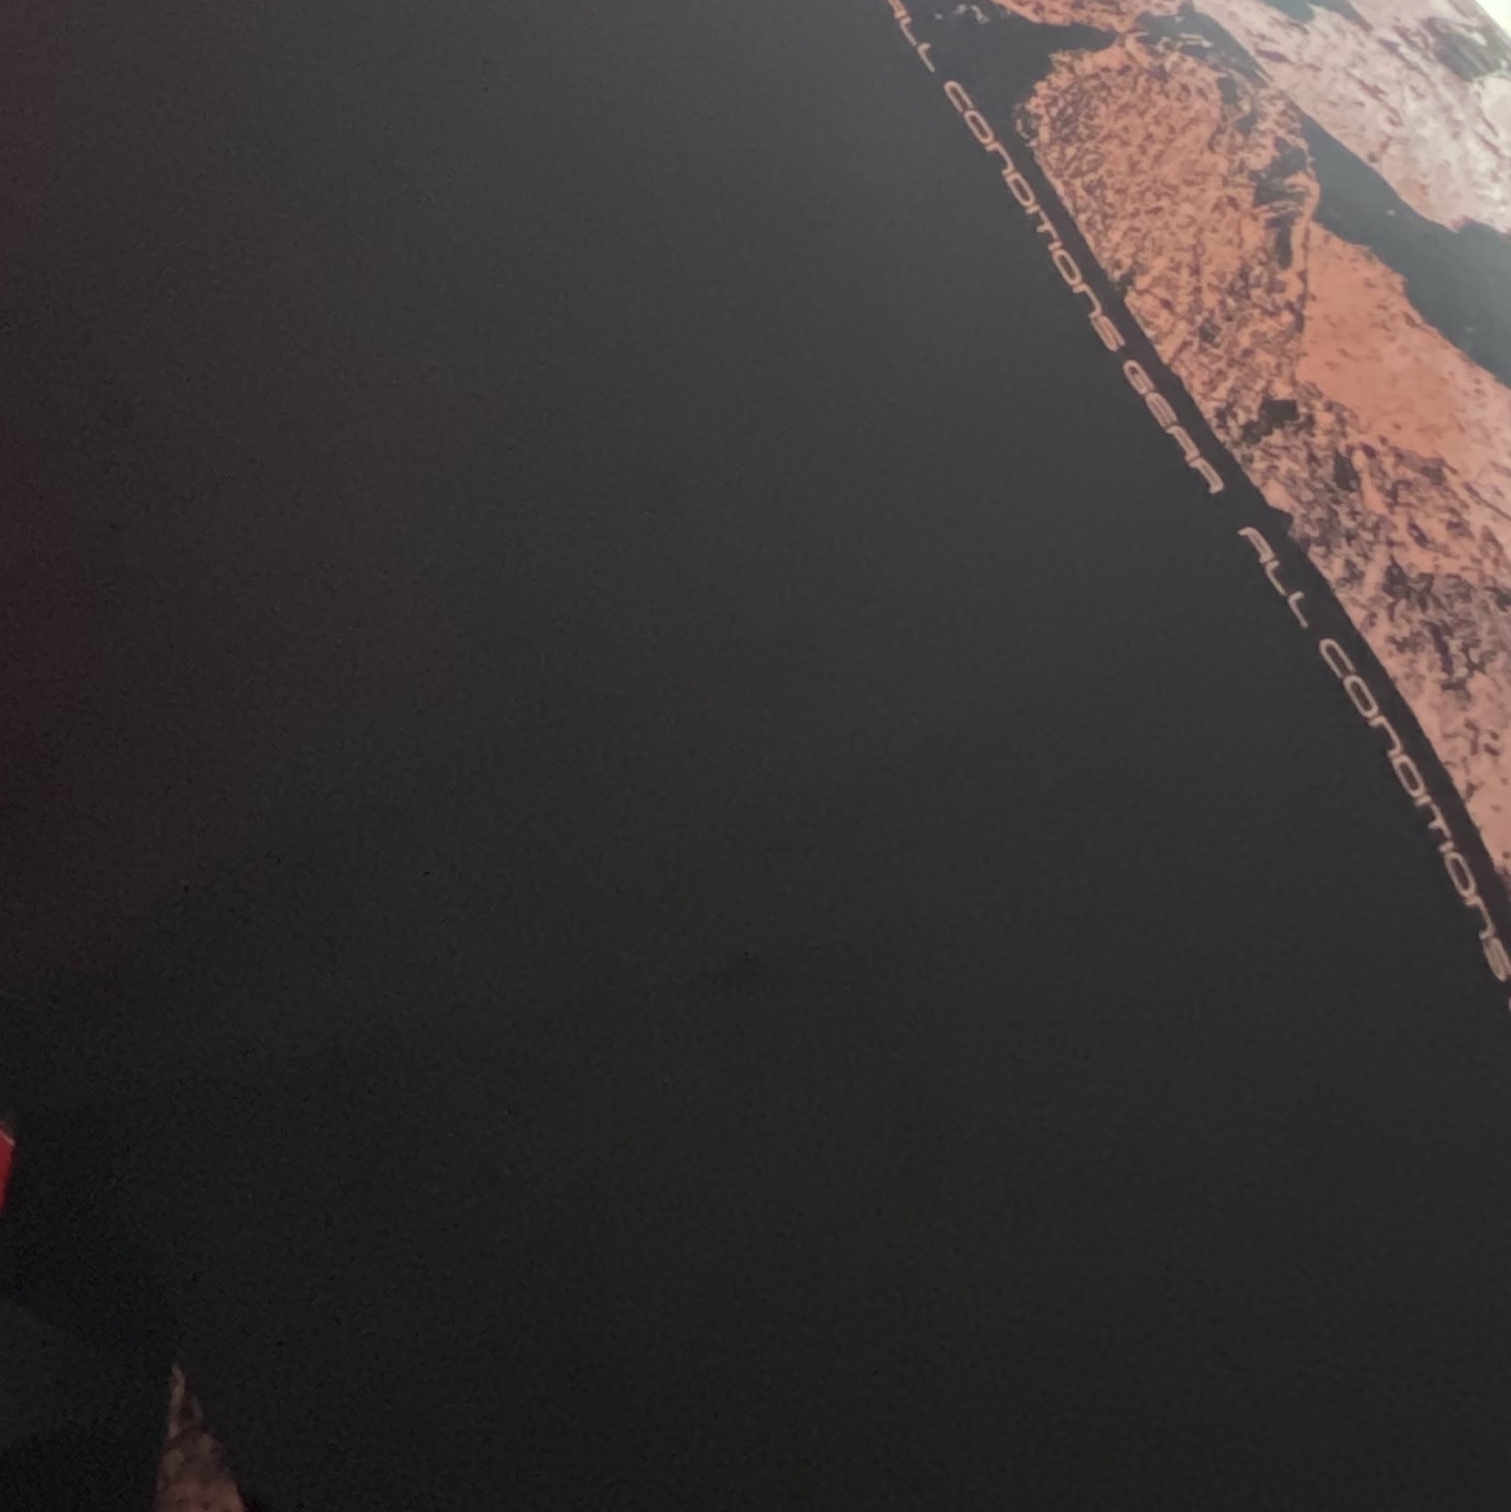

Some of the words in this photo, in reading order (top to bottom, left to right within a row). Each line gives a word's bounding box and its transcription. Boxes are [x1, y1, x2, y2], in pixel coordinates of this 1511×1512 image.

[944, 81, 1126, 352] CONDITIONS
[1123, 359, 1224, 494] GEAR
[1238, 526, 1308, 628] ALL
[1319, 638, 1511, 982] CONDITIONS
